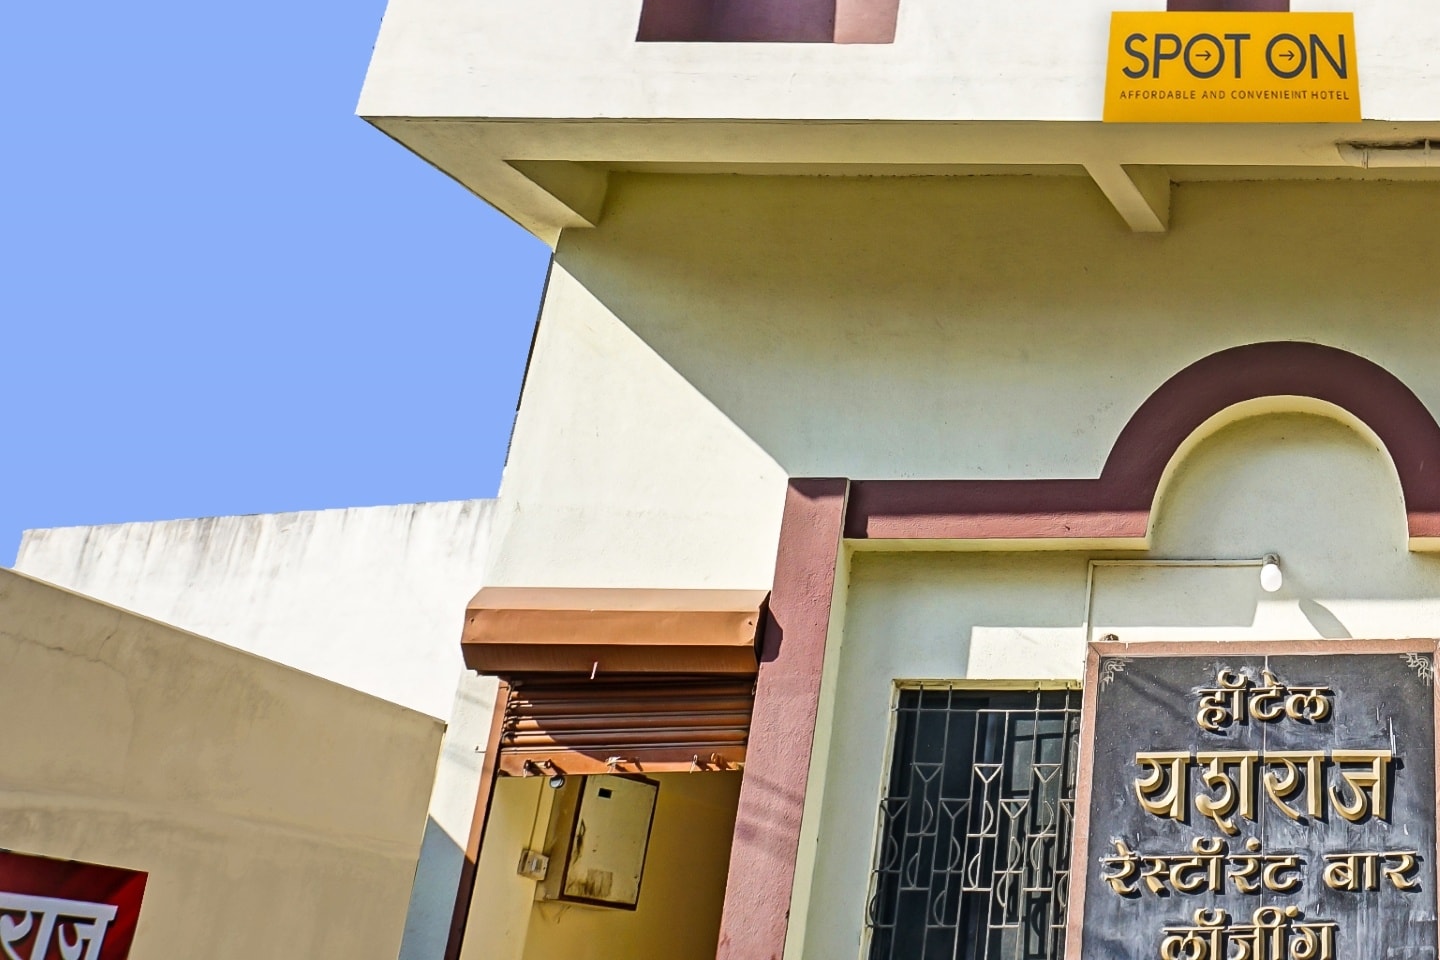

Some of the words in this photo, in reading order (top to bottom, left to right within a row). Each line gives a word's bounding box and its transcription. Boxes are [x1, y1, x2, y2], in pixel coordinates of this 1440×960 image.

[1122, 33, 1251, 79] SPOT
[1265, 33, 1348, 79] ON
[1119, 89, 1197, 100] AFFORDABLE
[1201, 89, 1226, 100] AND
[1310, 89, 1350, 100] HOTEL
[1197, 669, 1330, 731] हॉटेल
[1135, 749, 1392, 835] यशराज
[1101, 837, 1301, 895] रेस्टॉरंट
[1323, 851, 1419, 890] बार
